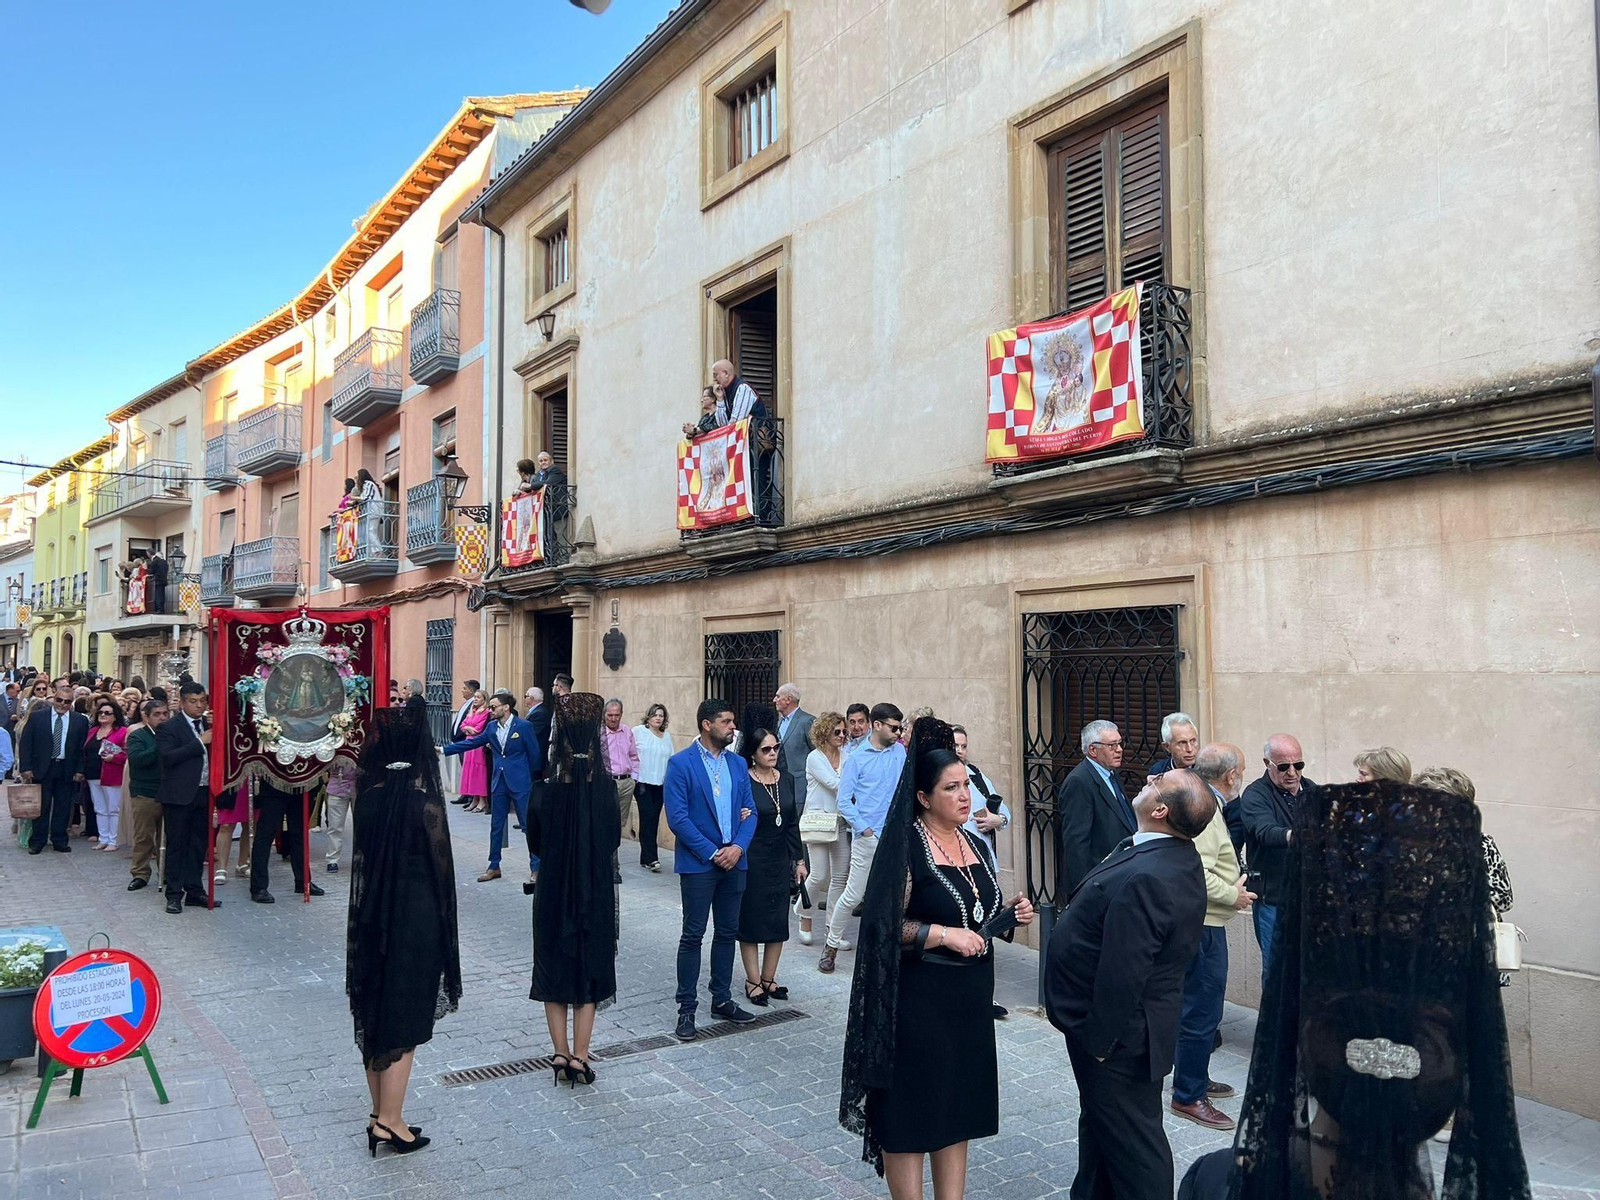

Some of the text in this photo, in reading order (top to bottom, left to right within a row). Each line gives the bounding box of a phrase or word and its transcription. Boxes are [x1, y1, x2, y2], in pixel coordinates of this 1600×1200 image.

[1068, 427, 1093, 437] COLLADO
[55, 965, 125, 985] PROHIBIDO ESTACIONAR
[57, 977, 126, 998] DESDE LAS 18:00 HORAS
[60, 990, 125, 1011] DEL LUNES 20-05-2024
[77, 1006, 111, 1019] PROCESION
